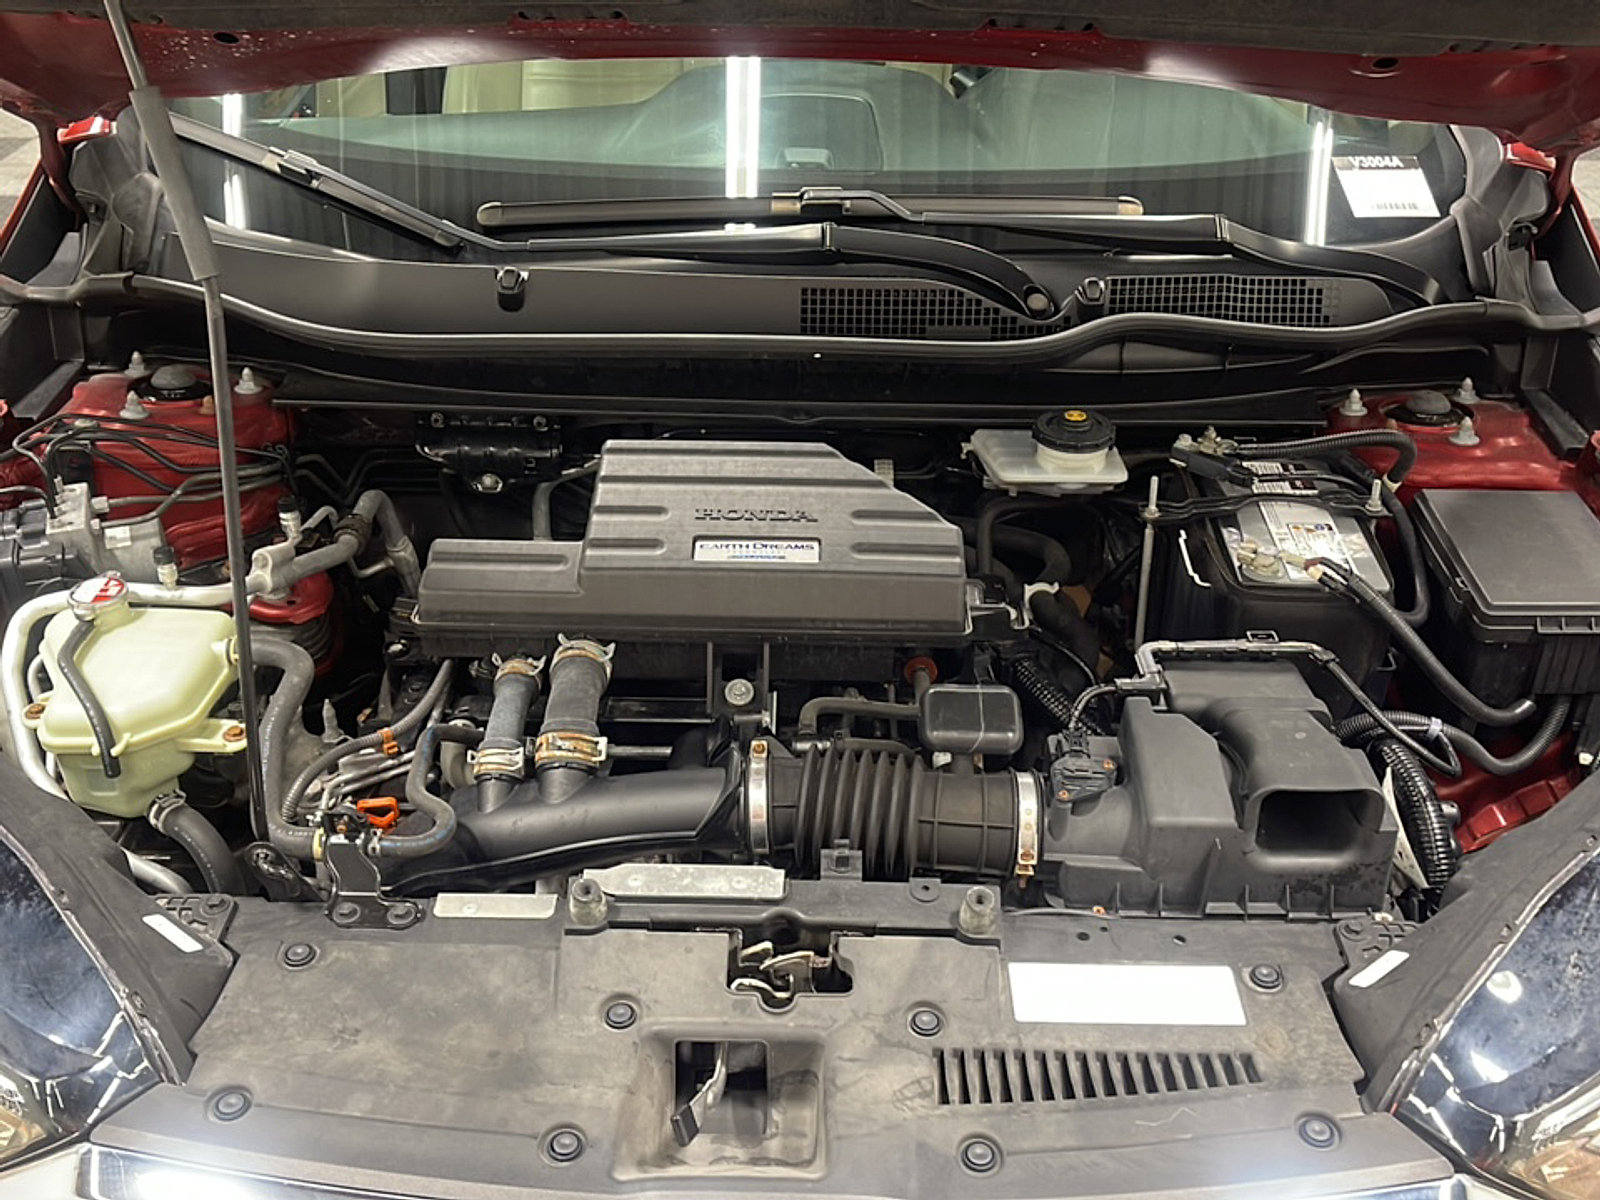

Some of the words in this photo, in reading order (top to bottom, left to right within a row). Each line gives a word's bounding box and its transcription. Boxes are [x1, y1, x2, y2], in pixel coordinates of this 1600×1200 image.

[694, 508, 819, 523] HONDA
[699, 543, 750, 551] EARTH
[752, 542, 815, 551] DREAMS
